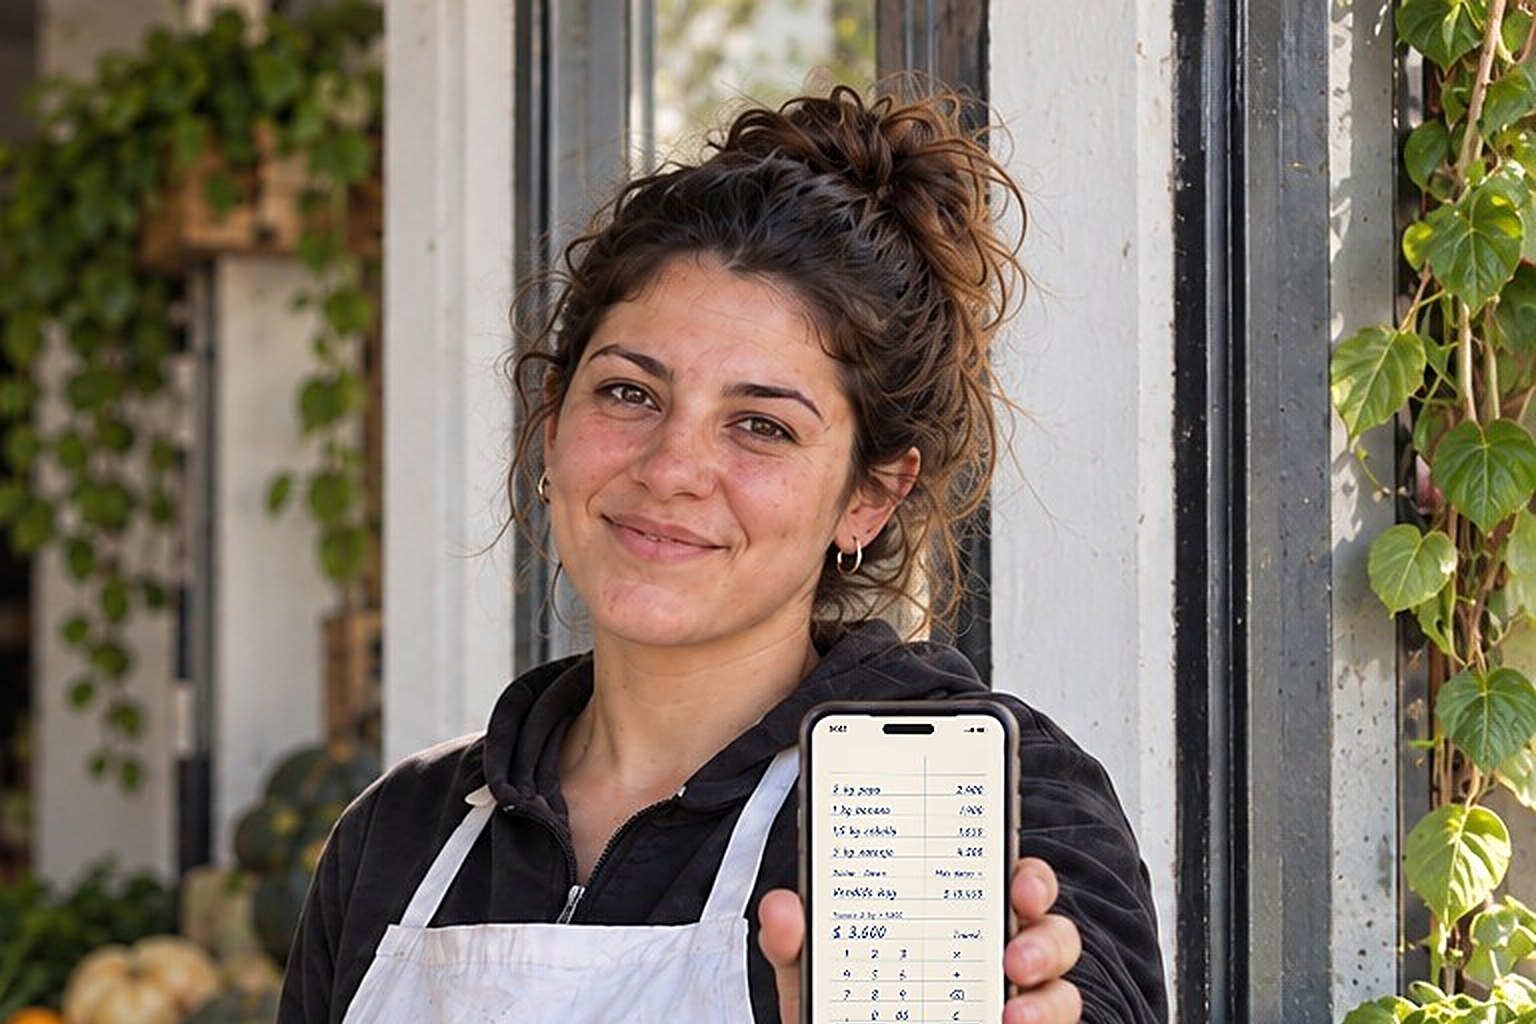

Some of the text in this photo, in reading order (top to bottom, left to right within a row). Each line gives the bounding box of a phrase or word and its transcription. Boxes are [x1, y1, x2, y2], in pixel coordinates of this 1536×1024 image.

[833, 925, 887, 939] $ 3.600
[871, 949, 879, 959] 2
[899, 949, 907, 960] 3
[871, 969, 879, 980] 5
[899, 969, 907, 980] 6
[843, 989, 907, 1001] 7 8 9
